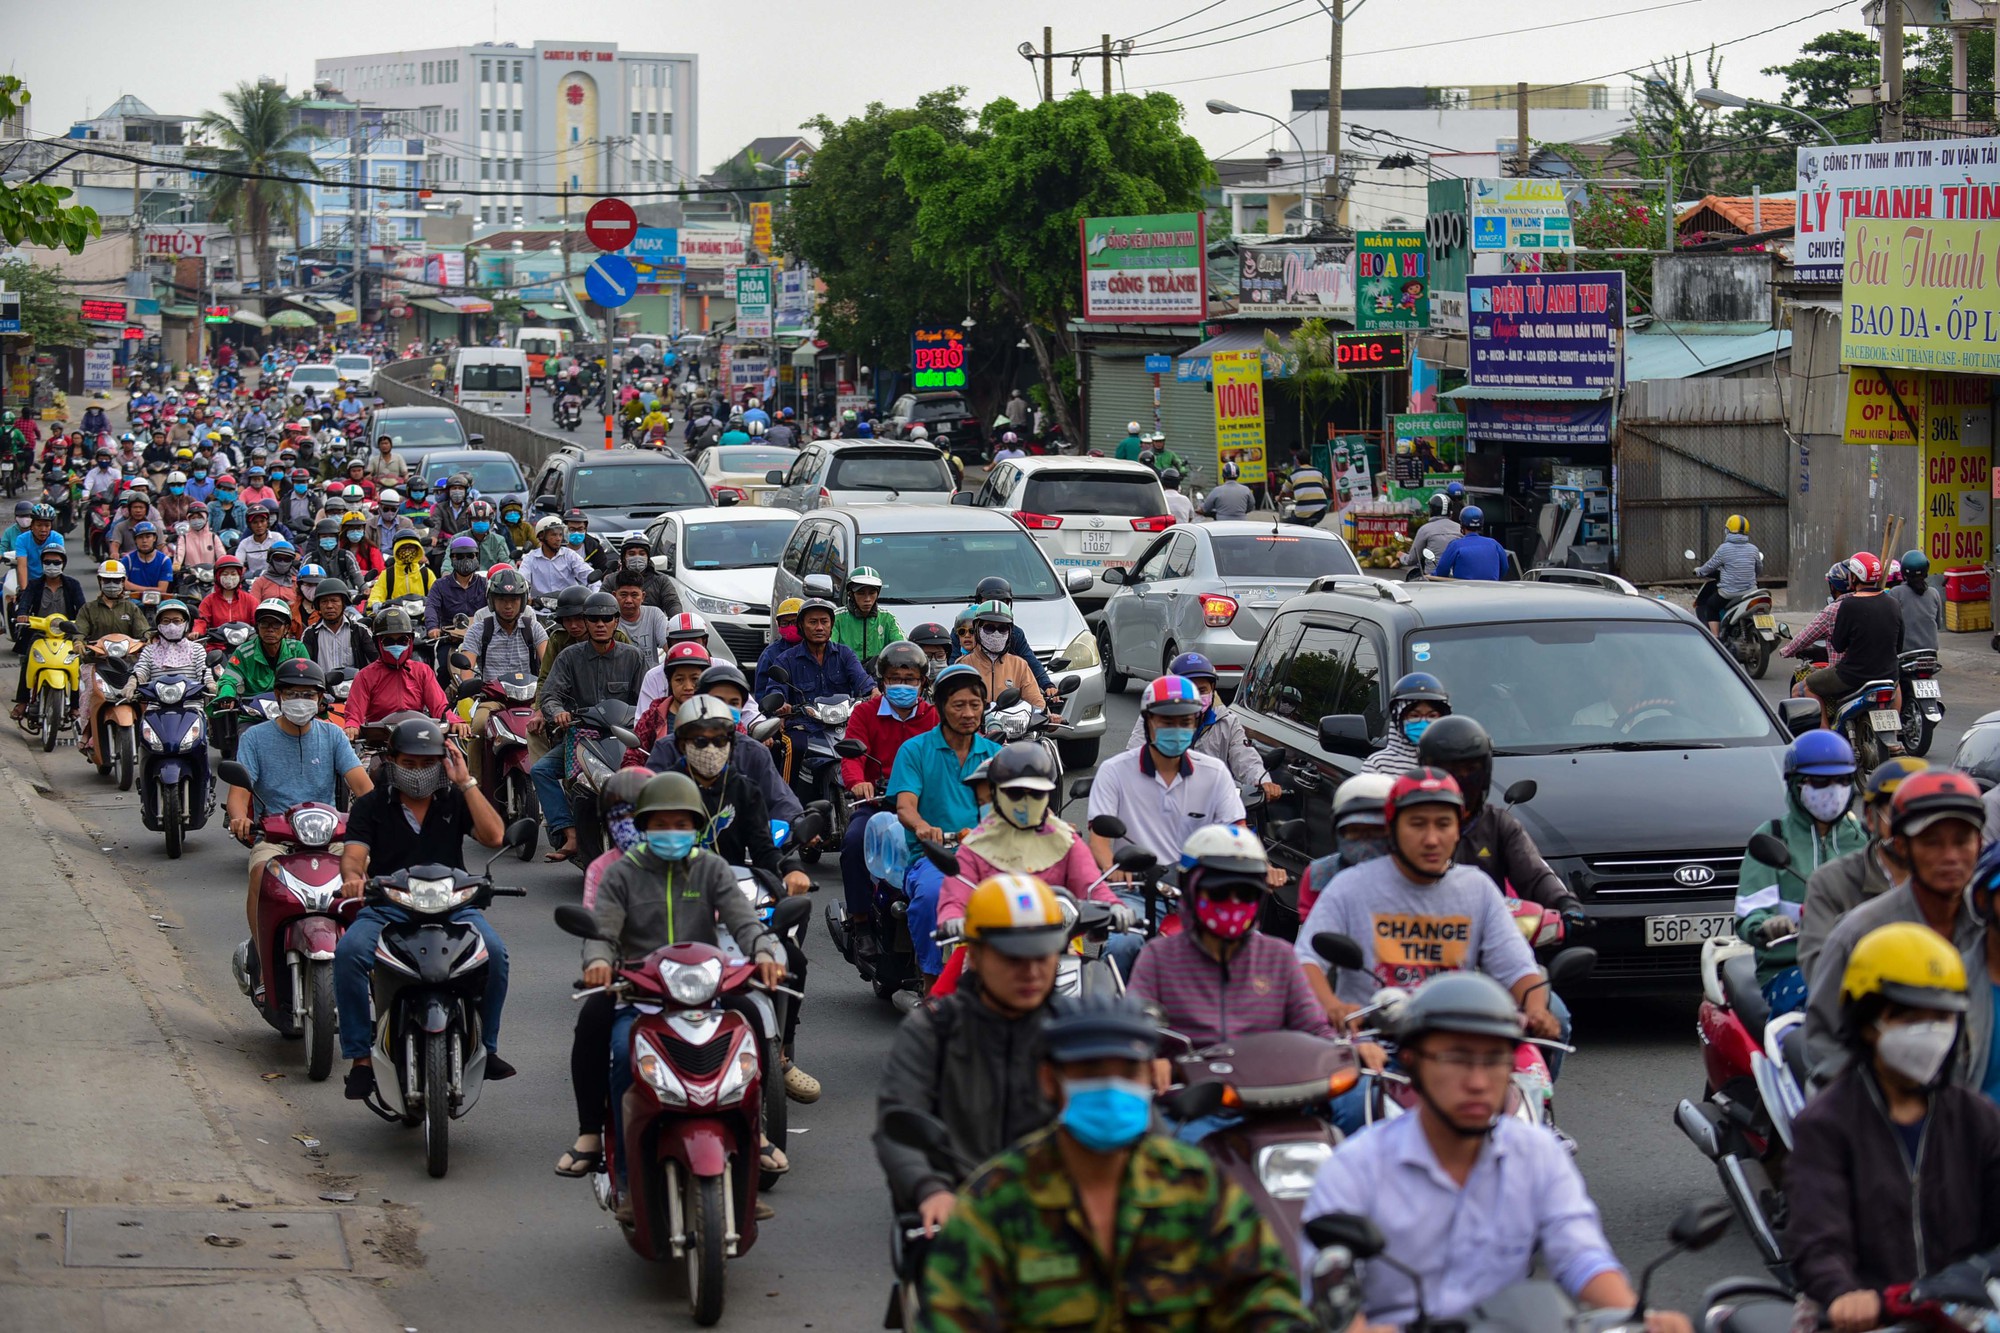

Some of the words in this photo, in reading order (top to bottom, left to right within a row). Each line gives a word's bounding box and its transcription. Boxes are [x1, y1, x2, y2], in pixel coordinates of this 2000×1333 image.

[577, 50, 593, 62] VIỆT
[597, 52, 613, 61] NAM
[1823, 152, 1848, 171] CÔNG
[1851, 154, 1862, 170] TY
[1864, 153, 1889, 169] TNHH
[1894, 151, 1915, 168] MTV
[1917, 150, 1932, 166] TM
[1941, 148, 1955, 166] DV
[1957, 145, 1978, 169] VẬN
[1981, 142, 1998, 164] TẢI
[1799, 180, 1831, 232] LÝ
[1524, 217, 1541, 227] LONG
[635, 239, 663, 250] INAX
[1151, 232, 1174, 248] NAM
[1175, 230, 1196, 247] KIM
[1397, 237, 1421, 247] NON
[1360, 252, 1398, 283] HỌA
[1402, 252, 1425, 277] MI
[1850, 225, 1890, 285] Sài
[1901, 225, 1986, 289] Thành
[1148, 268, 1198, 293] THÀNH
[740, 291, 767, 303] BÌNH
[1492, 279, 1524, 321] ĐIỆN
[1526, 277, 1545, 314] TỬ
[1546, 284, 1577, 313] ANH
[1850, 304, 1894, 336] BAO
[1899, 307, 1930, 338] DA
[1947, 295, 1978, 340] ỐP
[1520, 321, 1534, 338] SỬA
[1535, 322, 1554, 338] CHỮA
[1556, 324, 1572, 338] MUA
[1574, 321, 1590, 338] BÁN
[1592, 324, 1607, 338] TIVI
[915, 339, 964, 369] PHỞ
[1338, 342, 1383, 363] one
[1845, 345, 1889, 360] FACEBOOK:
[1936, 351, 1956, 366] CASE
[1963, 352, 1980, 367] HOT
[1217, 377, 1260, 419] VÕNG
[1931, 379, 1948, 405] TAI
[1397, 422, 1430, 431] COFFEE
[1433, 420, 1464, 430] QUEEN
[1932, 416, 1958, 441] 30k
[1929, 451, 1956, 484] CÁP
[1960, 456, 1986, 489] SẠC
[1930, 493, 1955, 517] 40k
[1089, 533, 1105, 541] 51H
[1932, 523, 1950, 559] CỦ
[1955, 531, 1983, 564] SẠC
[1680, 869, 1708, 881] KIA
[1376, 921, 1468, 940] CHANGE
[1401, 943, 1443, 960] THE
